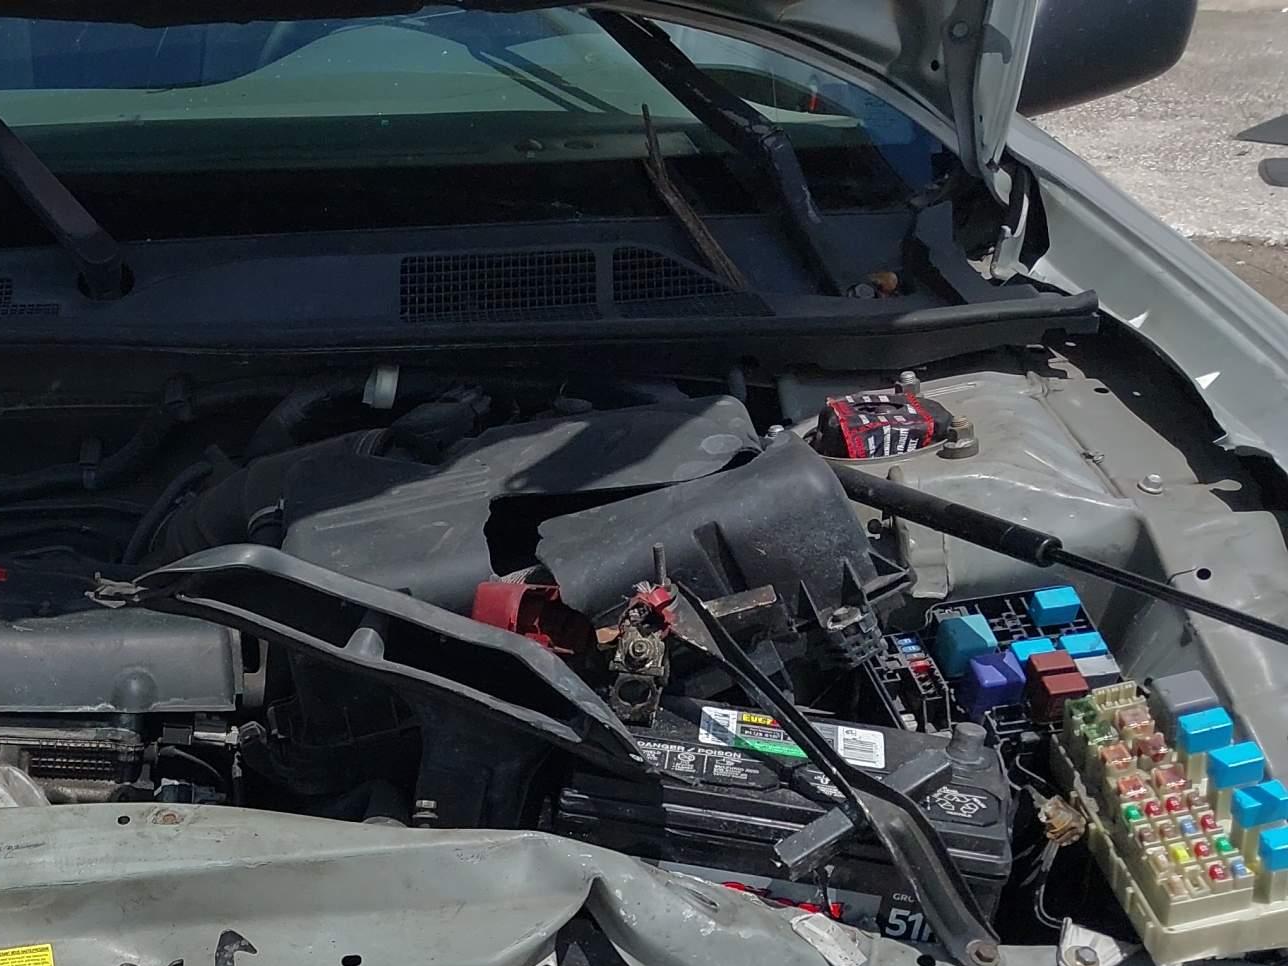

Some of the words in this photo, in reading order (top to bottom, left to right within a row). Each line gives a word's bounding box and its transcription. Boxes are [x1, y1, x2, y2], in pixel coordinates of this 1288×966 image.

[637, 741, 685, 753] DANGER
[698, 748, 742, 759] POISON
[892, 892, 915, 903] GRO
